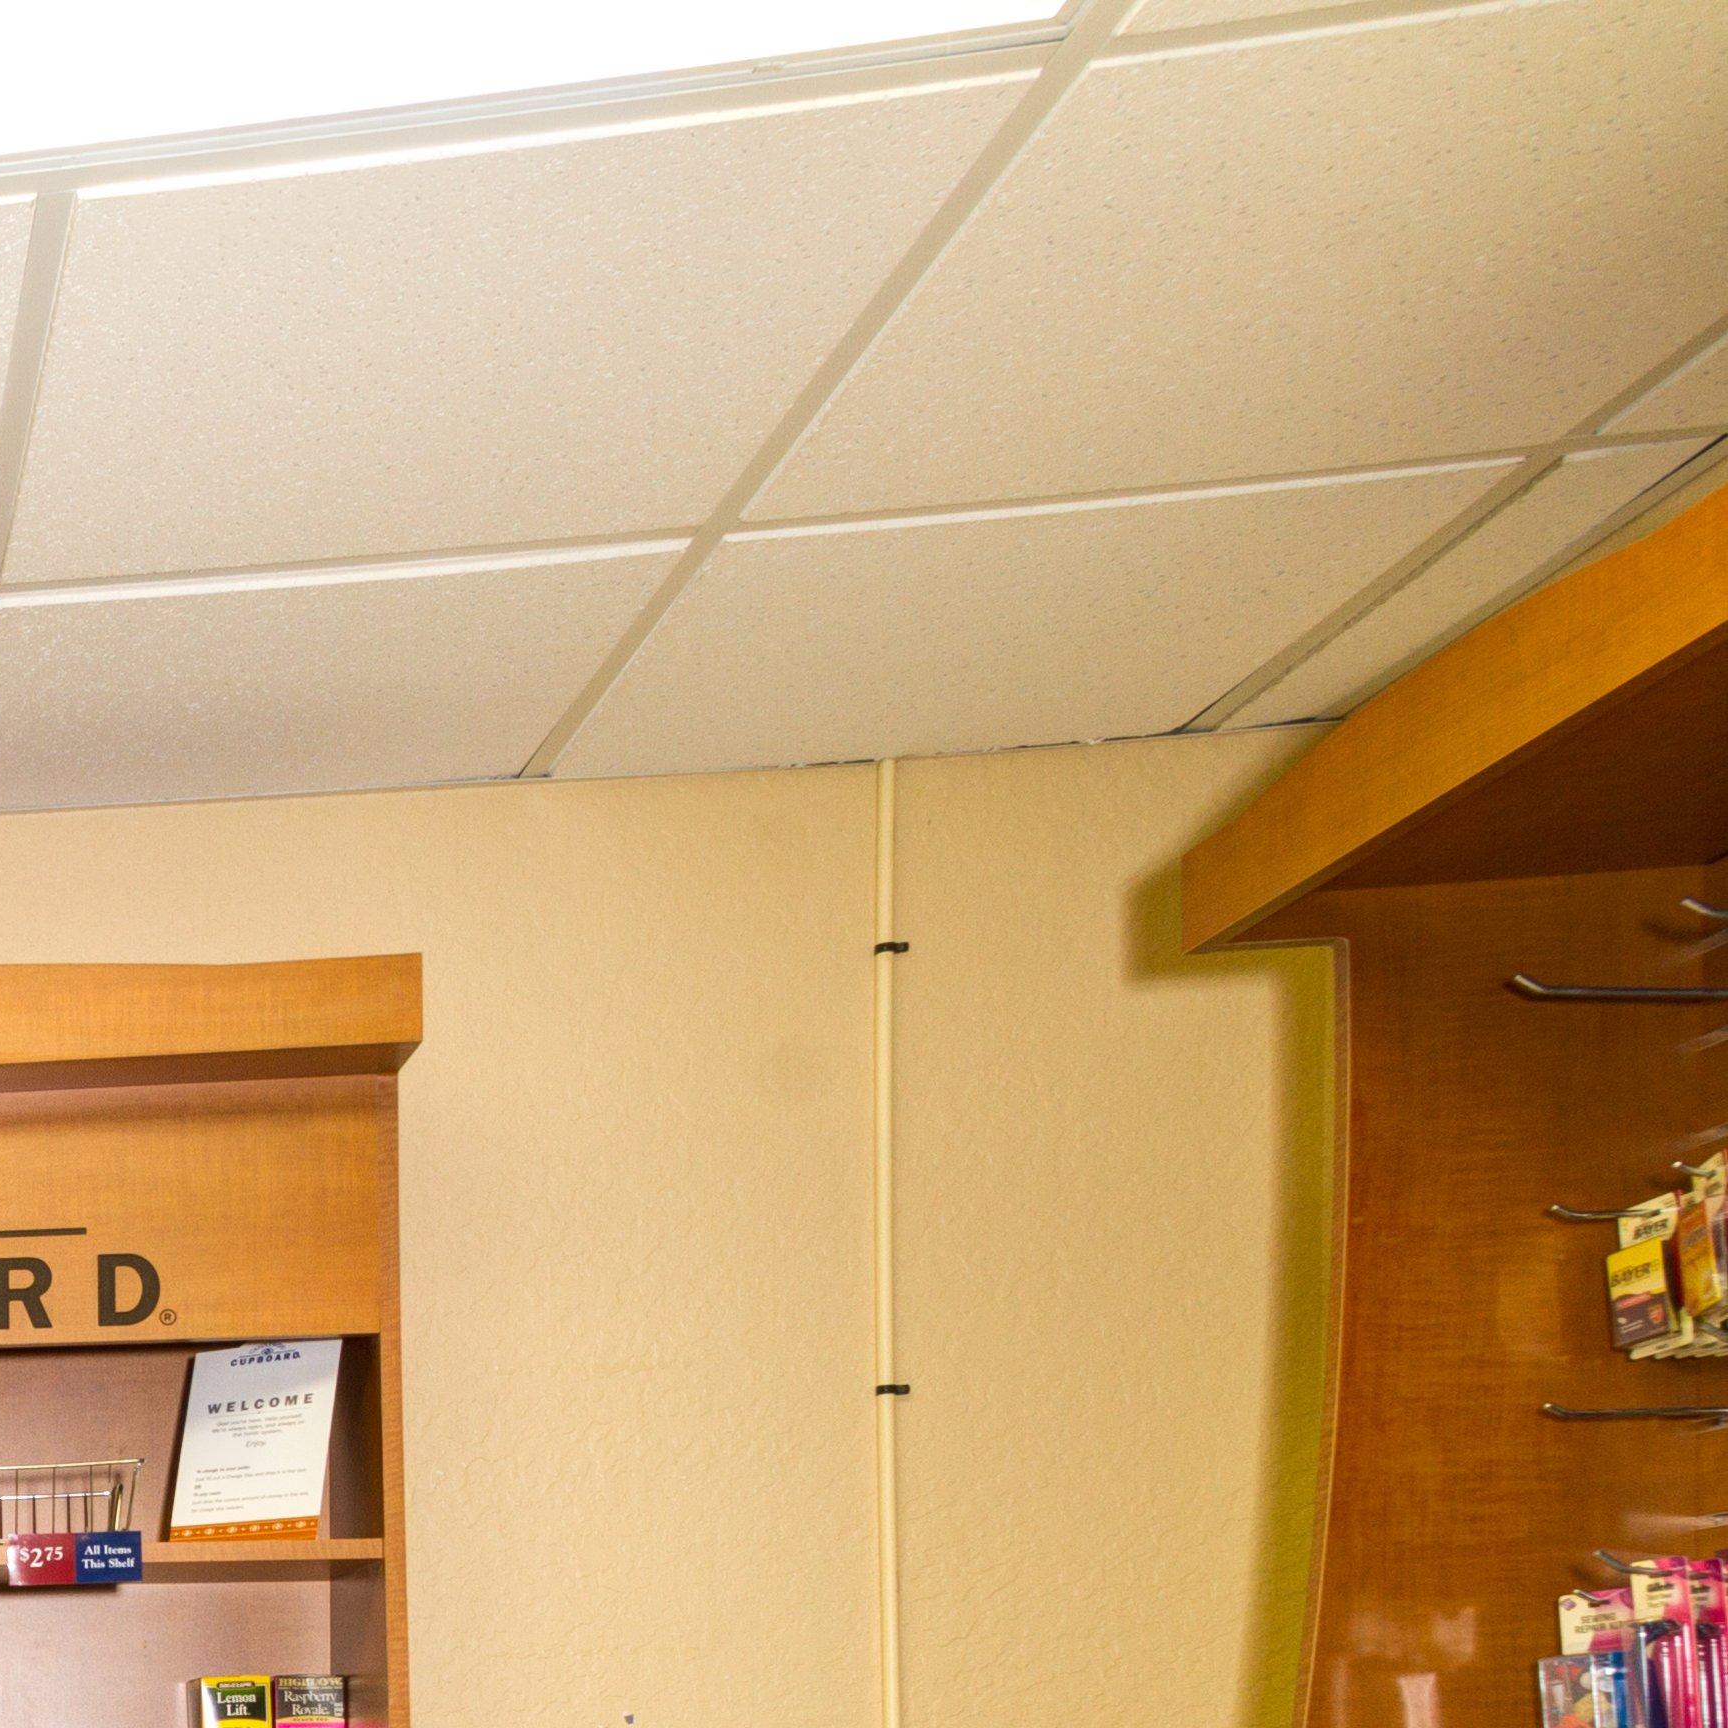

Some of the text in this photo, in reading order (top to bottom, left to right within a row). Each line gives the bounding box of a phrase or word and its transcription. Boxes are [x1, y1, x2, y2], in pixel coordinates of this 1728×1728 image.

[207, 1393, 314, 1414] WELCOME
[84, 1543, 133, 1555] All Items
[82, 1556, 136, 1570] This Shelf
[217, 1692, 257, 1704] Lemon
[284, 1690, 338, 1705] Raspberry
